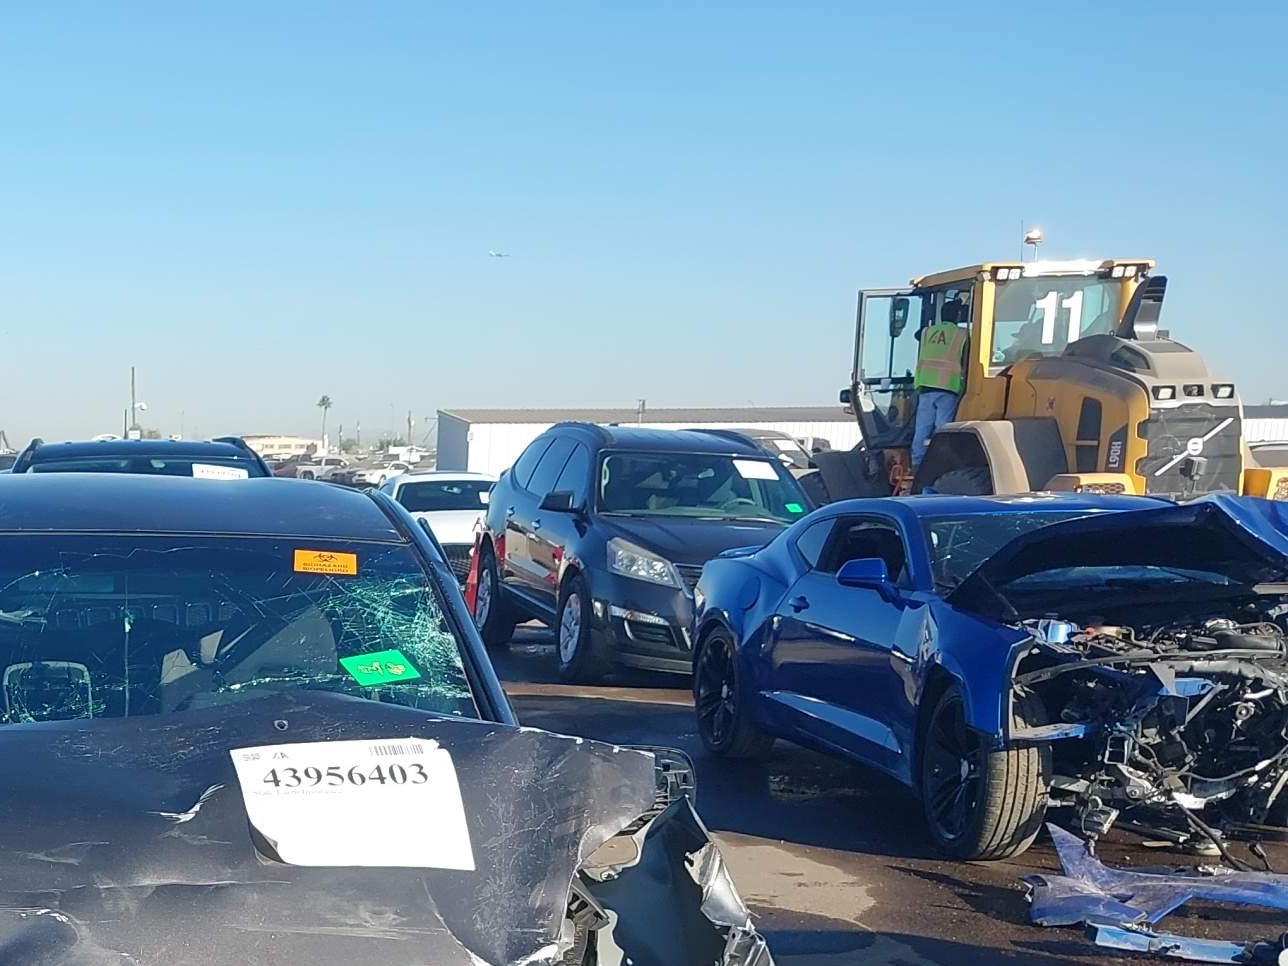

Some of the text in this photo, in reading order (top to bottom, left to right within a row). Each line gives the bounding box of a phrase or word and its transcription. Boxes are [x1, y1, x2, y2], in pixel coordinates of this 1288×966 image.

[1036, 291, 1083, 344] 11
[1108, 441, 1123, 468] L90H
[263, 763, 428, 788] 43956403
